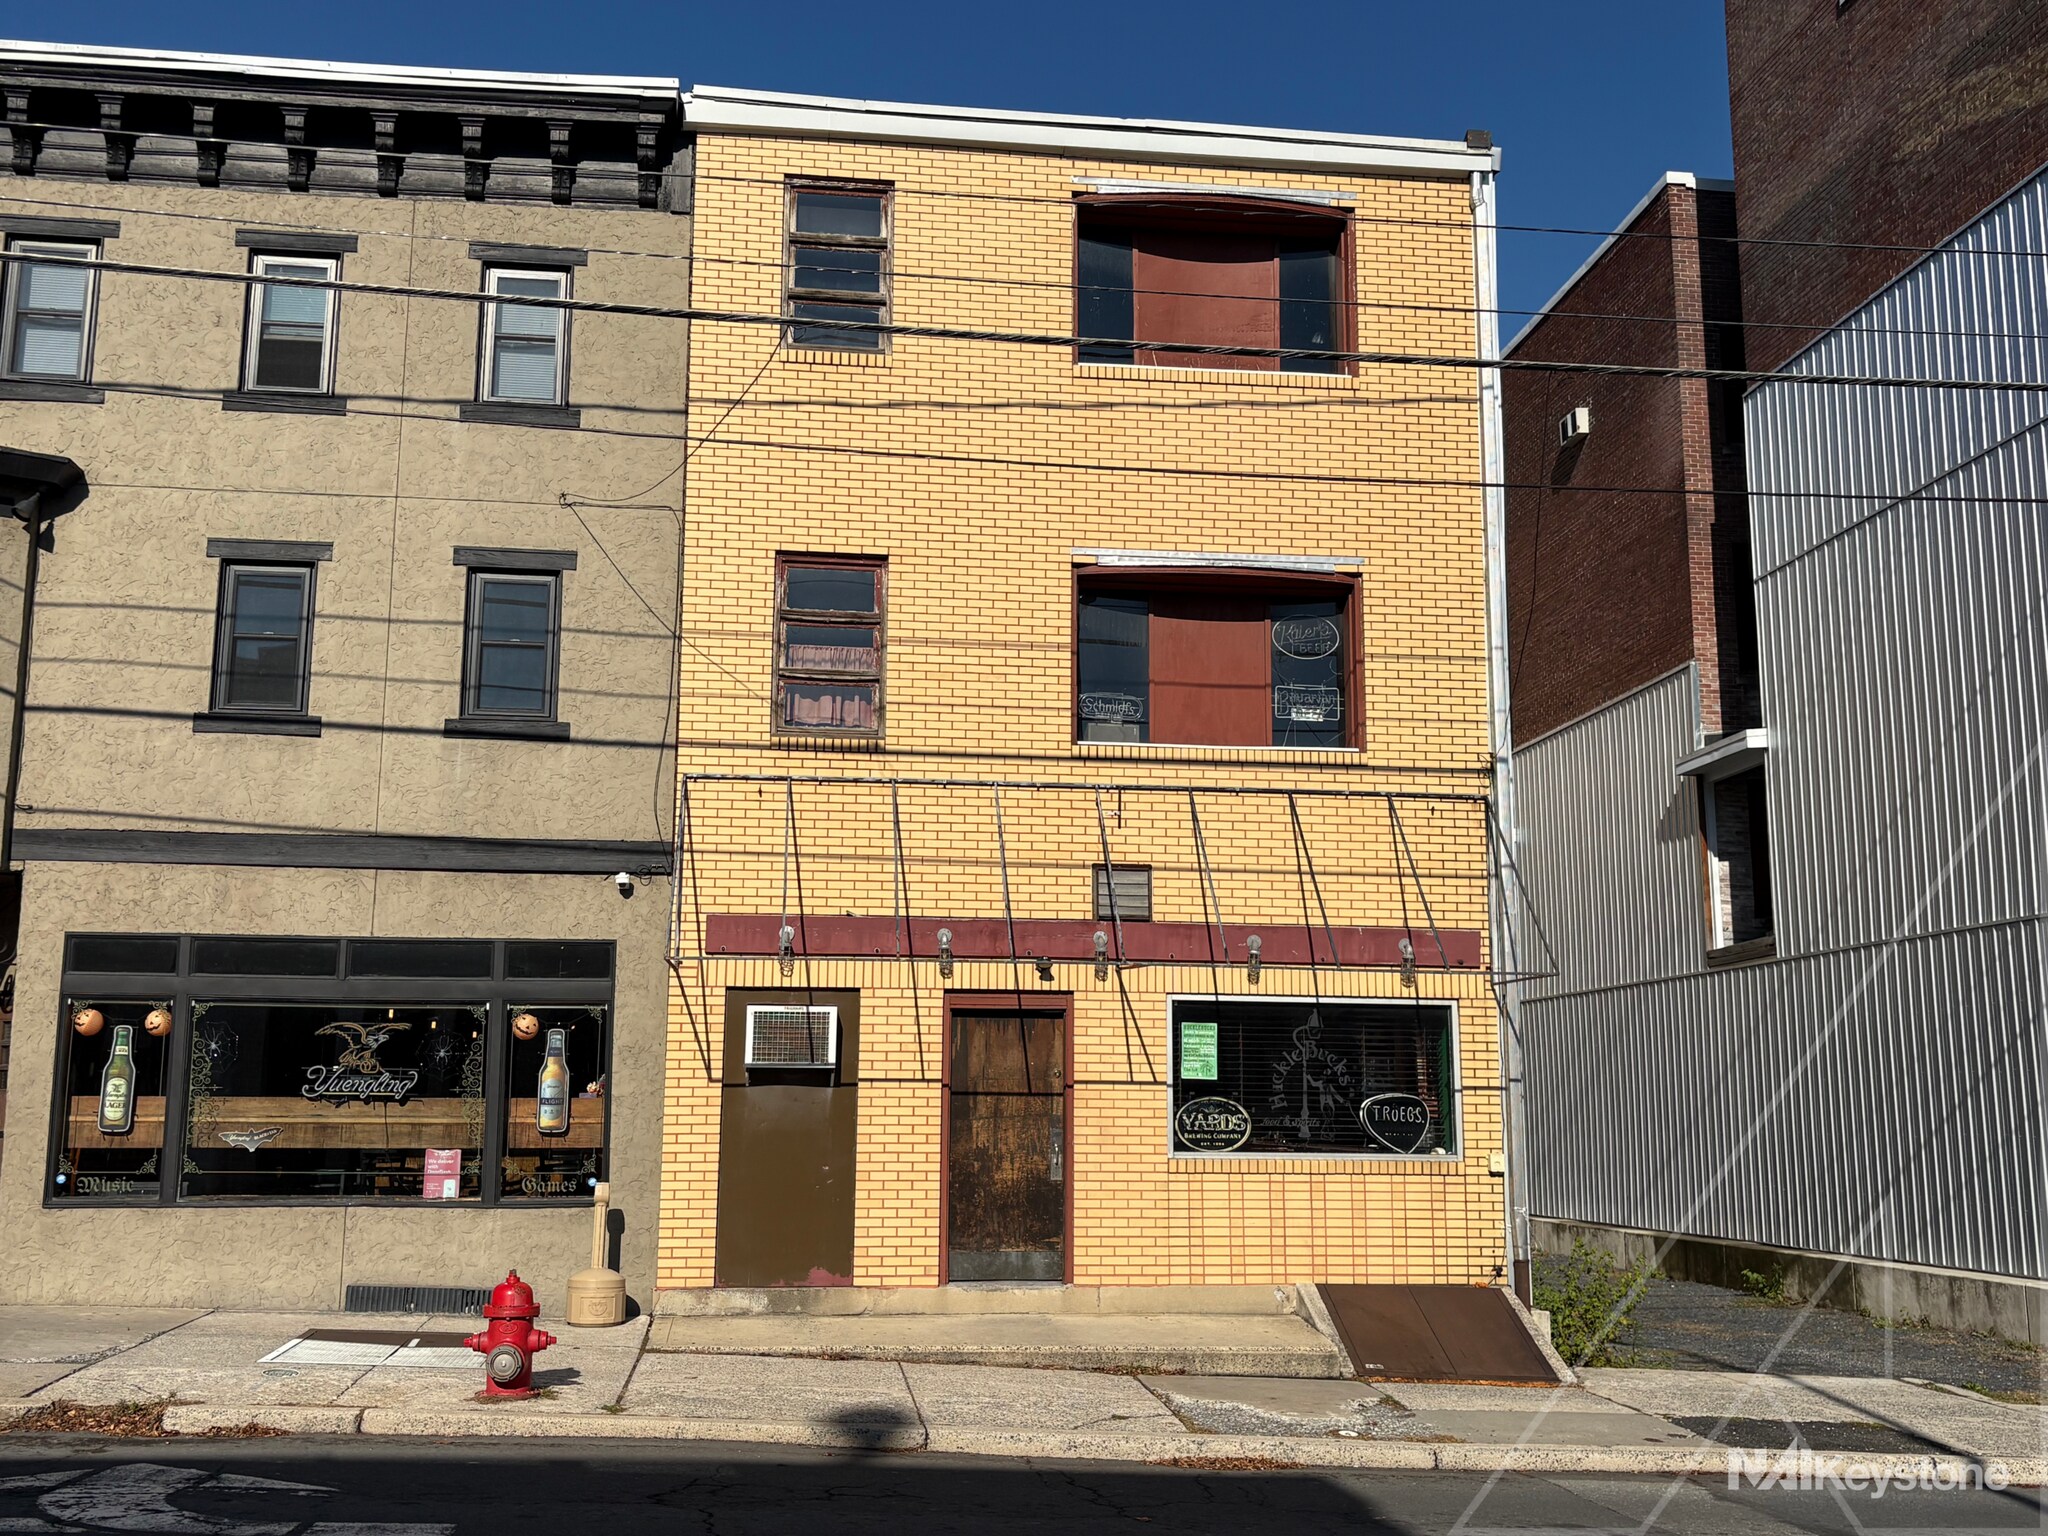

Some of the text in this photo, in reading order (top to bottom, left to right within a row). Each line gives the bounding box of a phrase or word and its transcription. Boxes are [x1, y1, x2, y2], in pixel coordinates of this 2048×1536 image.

[1299, 642, 1330, 654] BEER
[302, 1065, 418, 1100] Yuengling
[1181, 1112, 1247, 1131] YARDS
[76, 1176, 134, 1193] Music
[521, 1176, 577, 1193] Games
